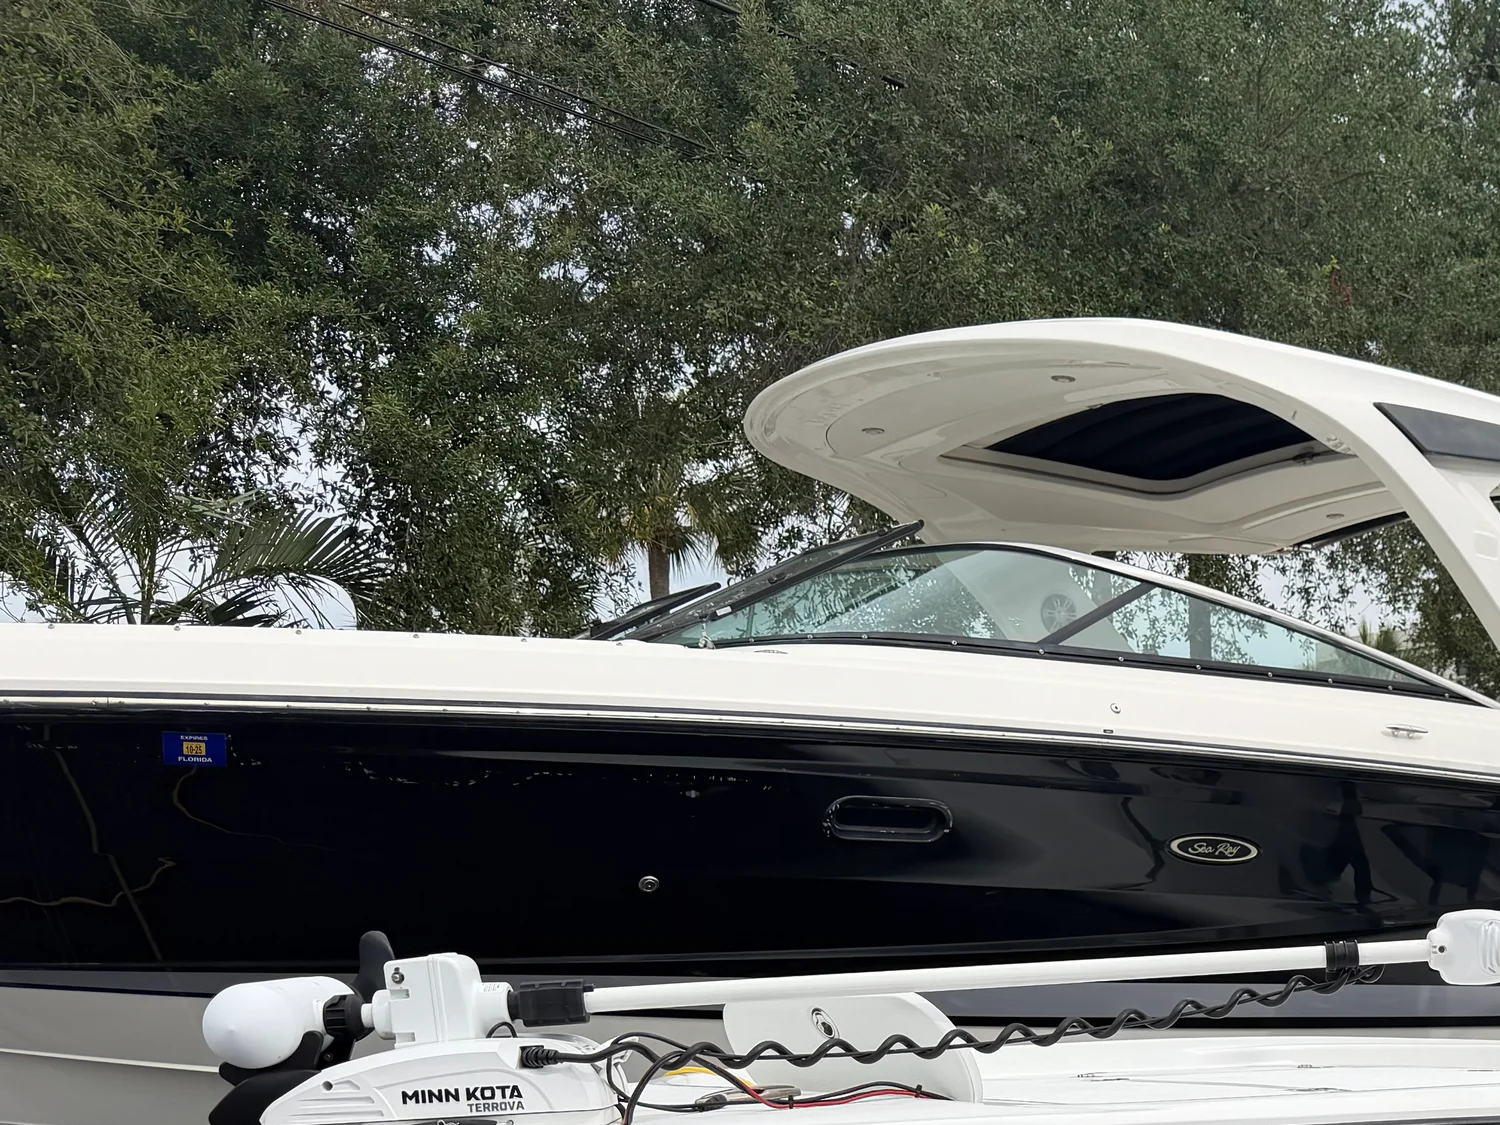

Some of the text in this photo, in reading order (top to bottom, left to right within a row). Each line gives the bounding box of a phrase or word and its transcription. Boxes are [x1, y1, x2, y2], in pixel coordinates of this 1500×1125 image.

[185, 745, 203, 755] 10-25
[1188, 842, 1241, 857] Sea Ray
[401, 1085, 524, 1105] MINN KOTA
[467, 1101, 525, 1113] TERROVA
